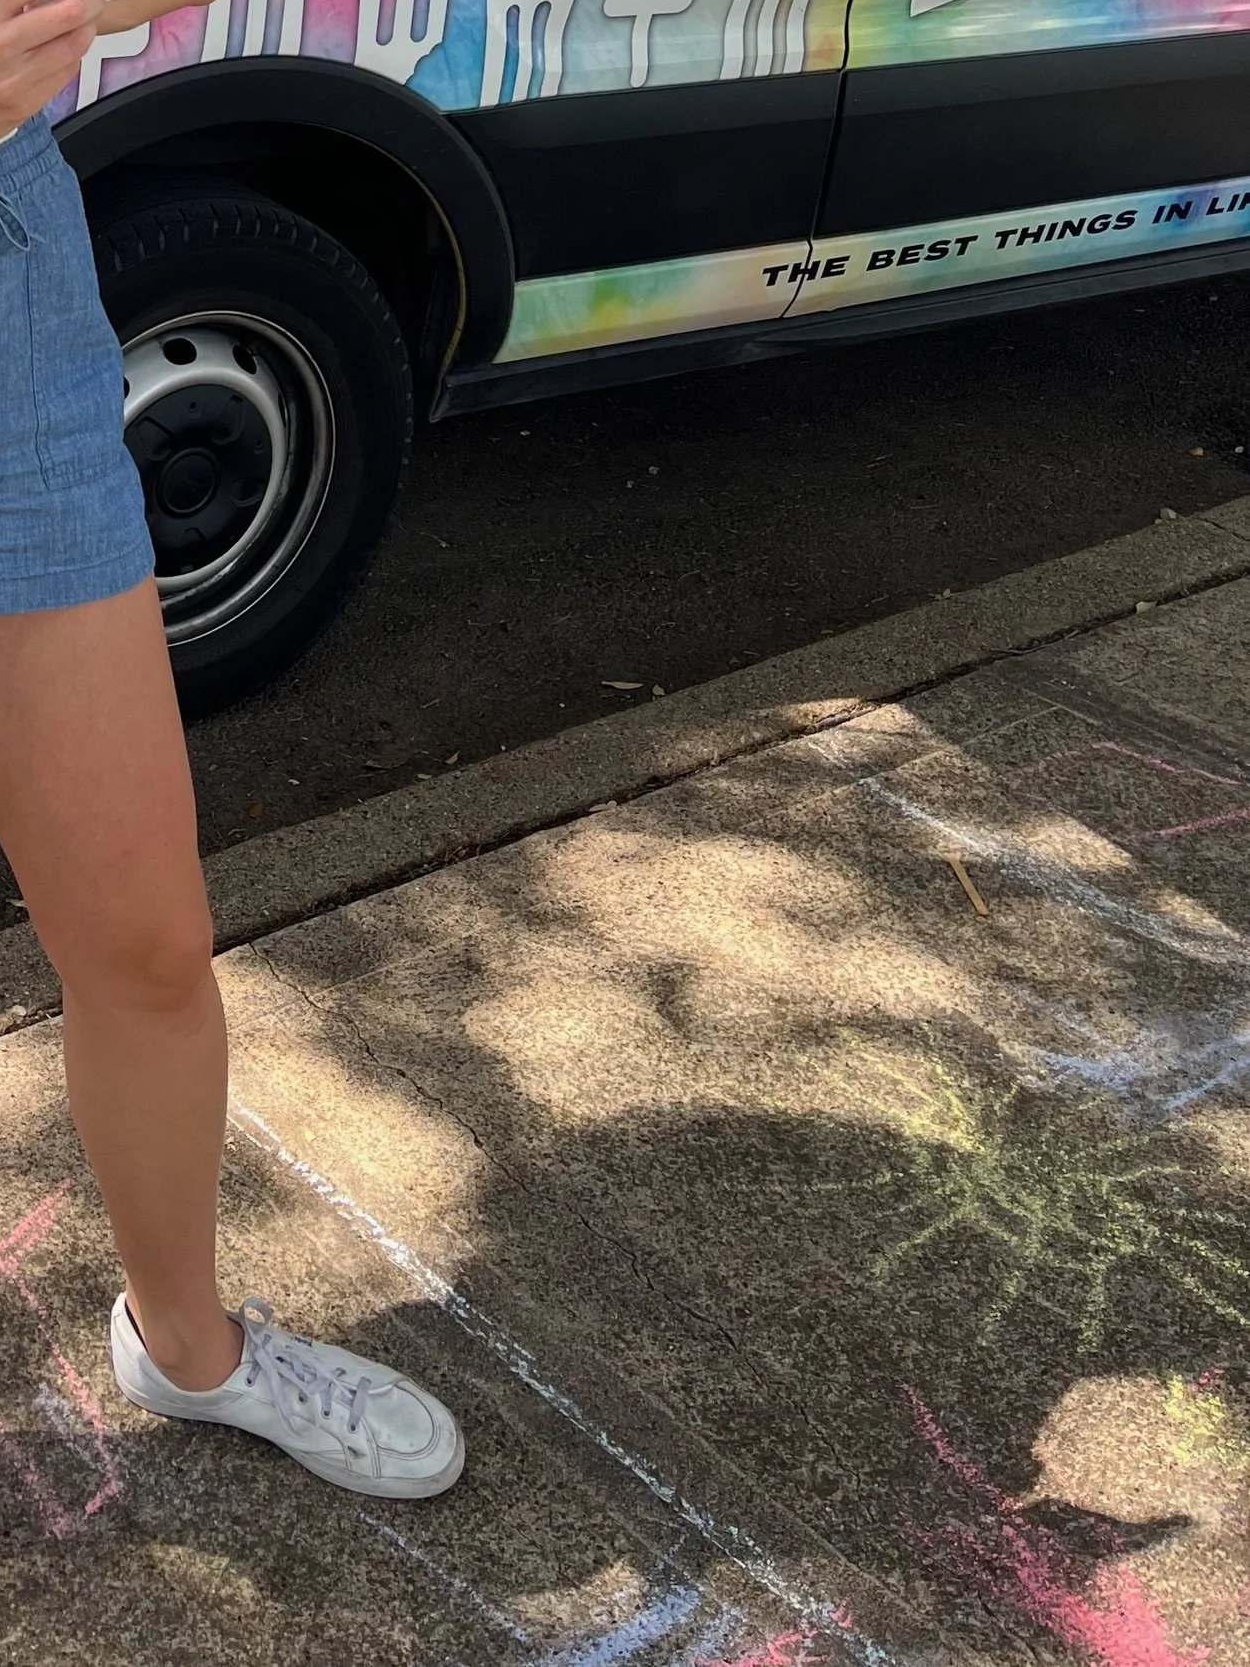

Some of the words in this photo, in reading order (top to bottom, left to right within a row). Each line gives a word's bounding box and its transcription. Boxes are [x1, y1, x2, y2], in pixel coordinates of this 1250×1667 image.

[762, 255, 850, 287] THE
[866, 235, 978, 272] BEST
[994, 209, 1138, 250] THINGS
[1152, 200, 1193, 225] IN
